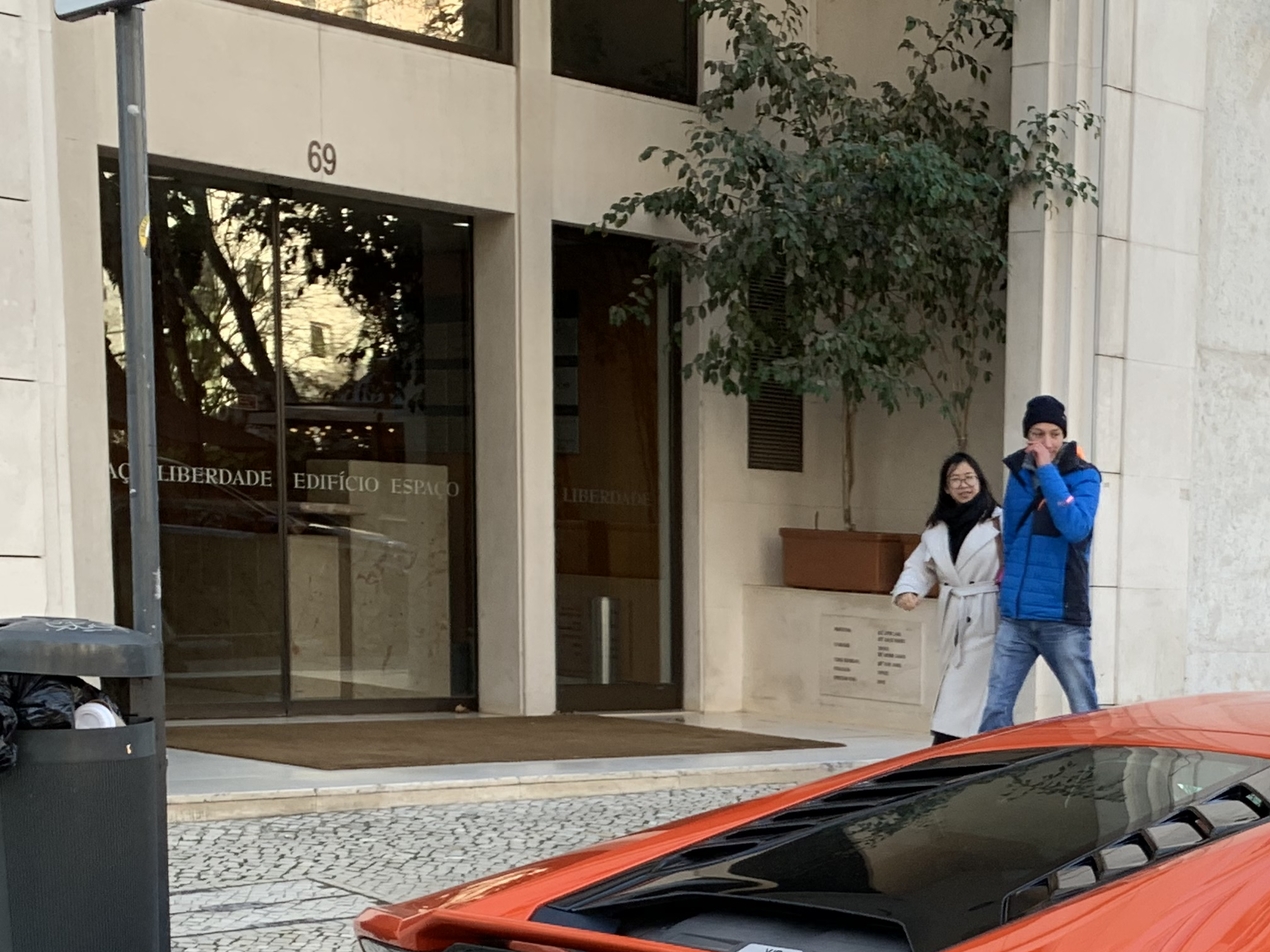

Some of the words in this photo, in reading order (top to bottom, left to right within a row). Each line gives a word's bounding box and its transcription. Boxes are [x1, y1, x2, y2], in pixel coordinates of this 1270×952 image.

[308, 140, 336, 175] 69
[157, 465, 273, 488] LIBERDADE
[293, 471, 379, 492] EDIFÍCIO
[391, 478, 459, 500] ESPAÇO
